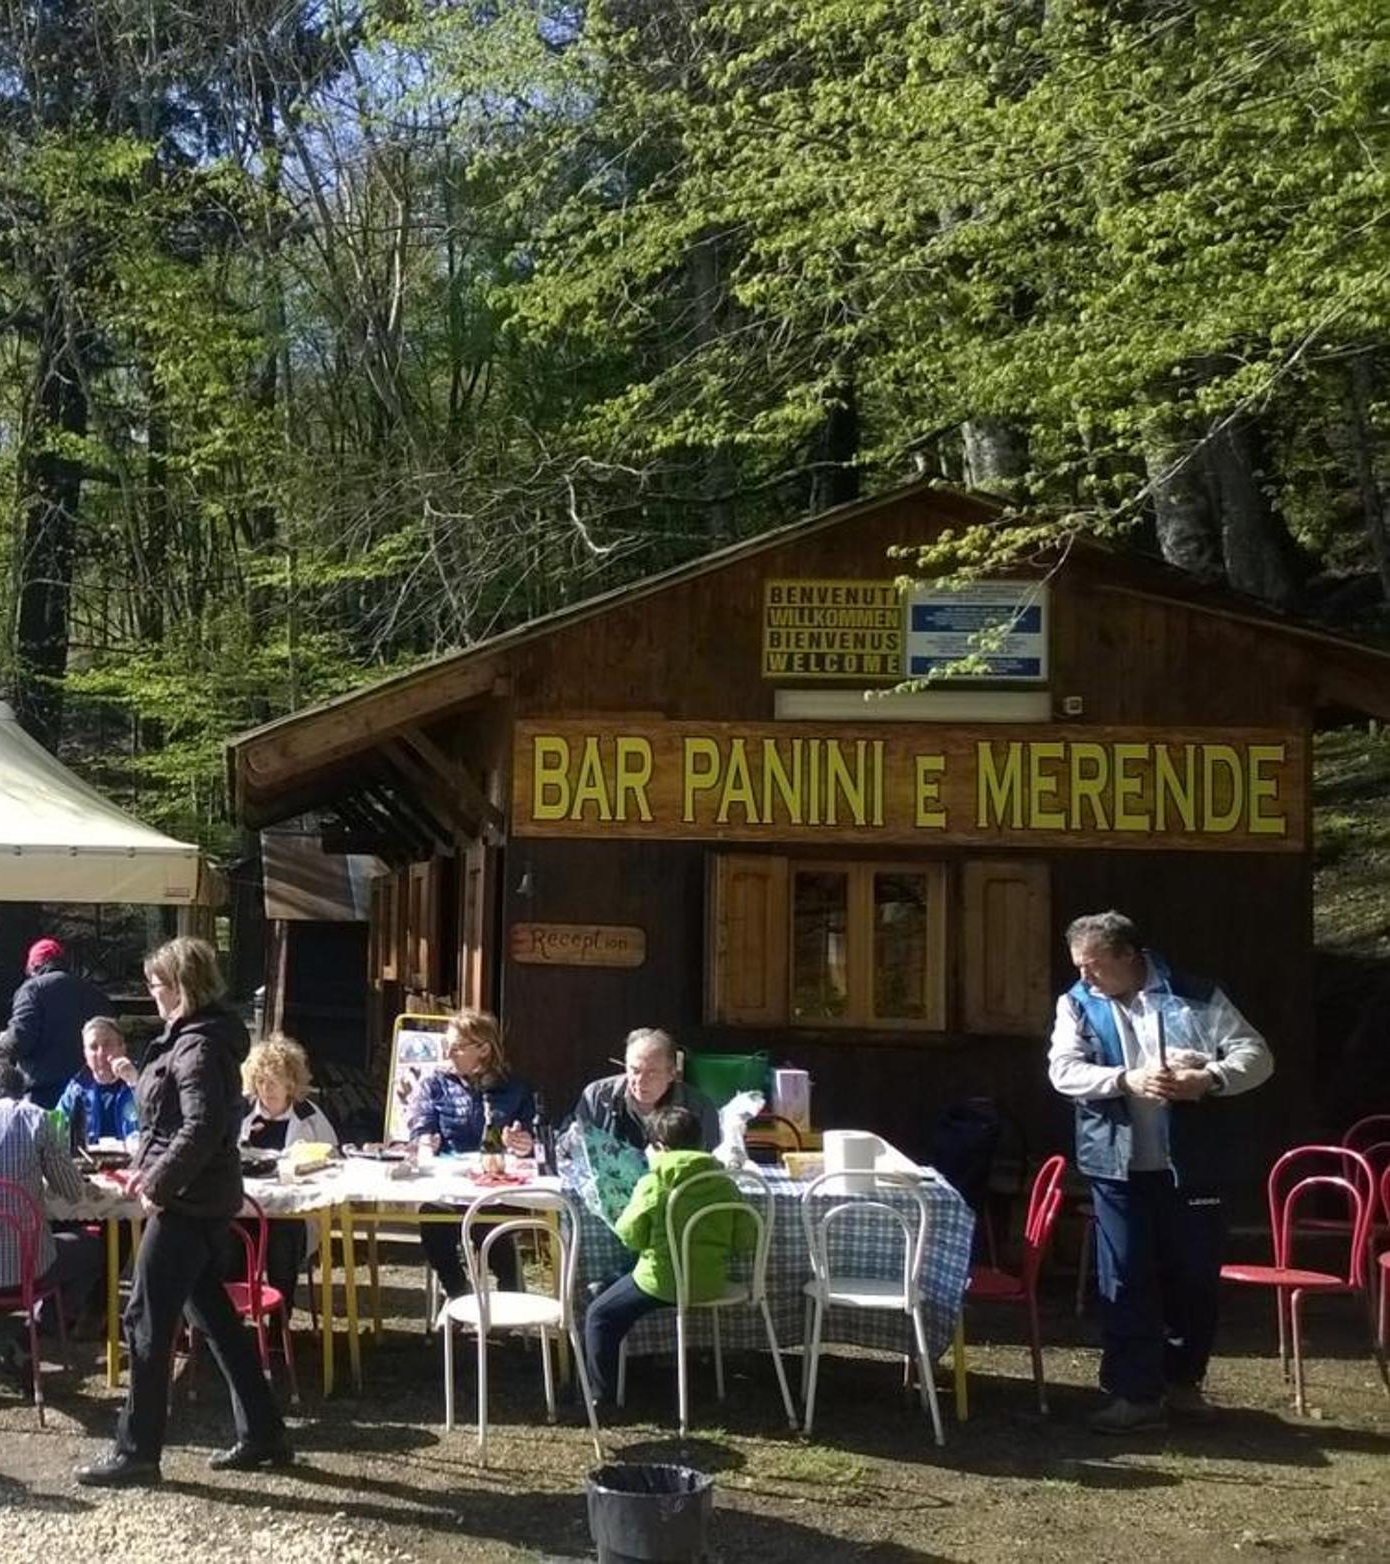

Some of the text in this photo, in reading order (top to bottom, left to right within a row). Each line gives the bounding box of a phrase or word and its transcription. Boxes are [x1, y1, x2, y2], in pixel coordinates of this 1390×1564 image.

[770, 586, 900, 605] BENVENUTI
[769, 608, 898, 628] WILLKOMMEN
[770, 631, 898, 650] BIENVENUS
[769, 653, 899, 673] WELCOME
[532, 735, 1286, 835] BAR PANINI E MERENDE
[530, 928, 628, 961] Reception
